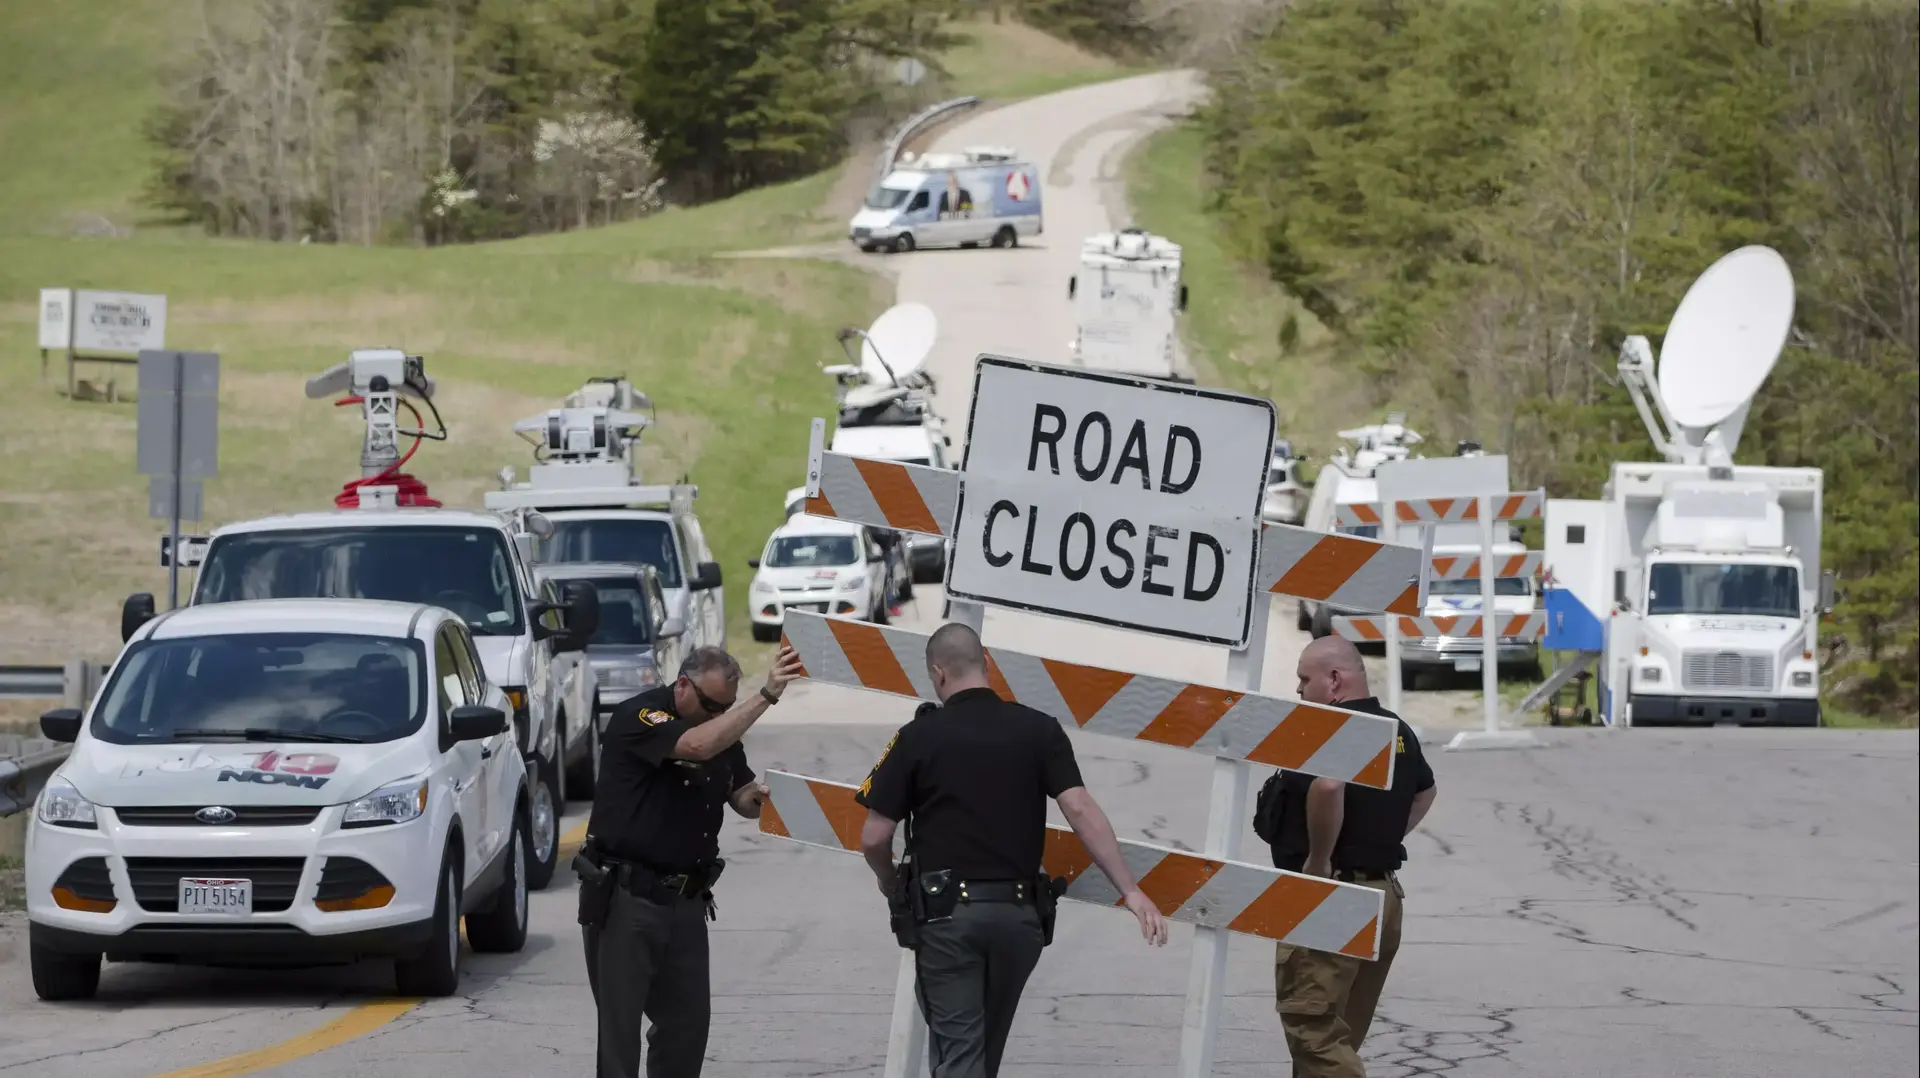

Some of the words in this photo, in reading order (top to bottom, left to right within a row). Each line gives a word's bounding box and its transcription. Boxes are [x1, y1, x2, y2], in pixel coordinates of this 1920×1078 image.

[1027, 402, 1202, 495] ROAD
[982, 499, 1225, 602] CLOSED
[217, 769, 331, 790] NOW
[184, 887, 208, 905] PIT
[212, 888, 246, 906] 5154
